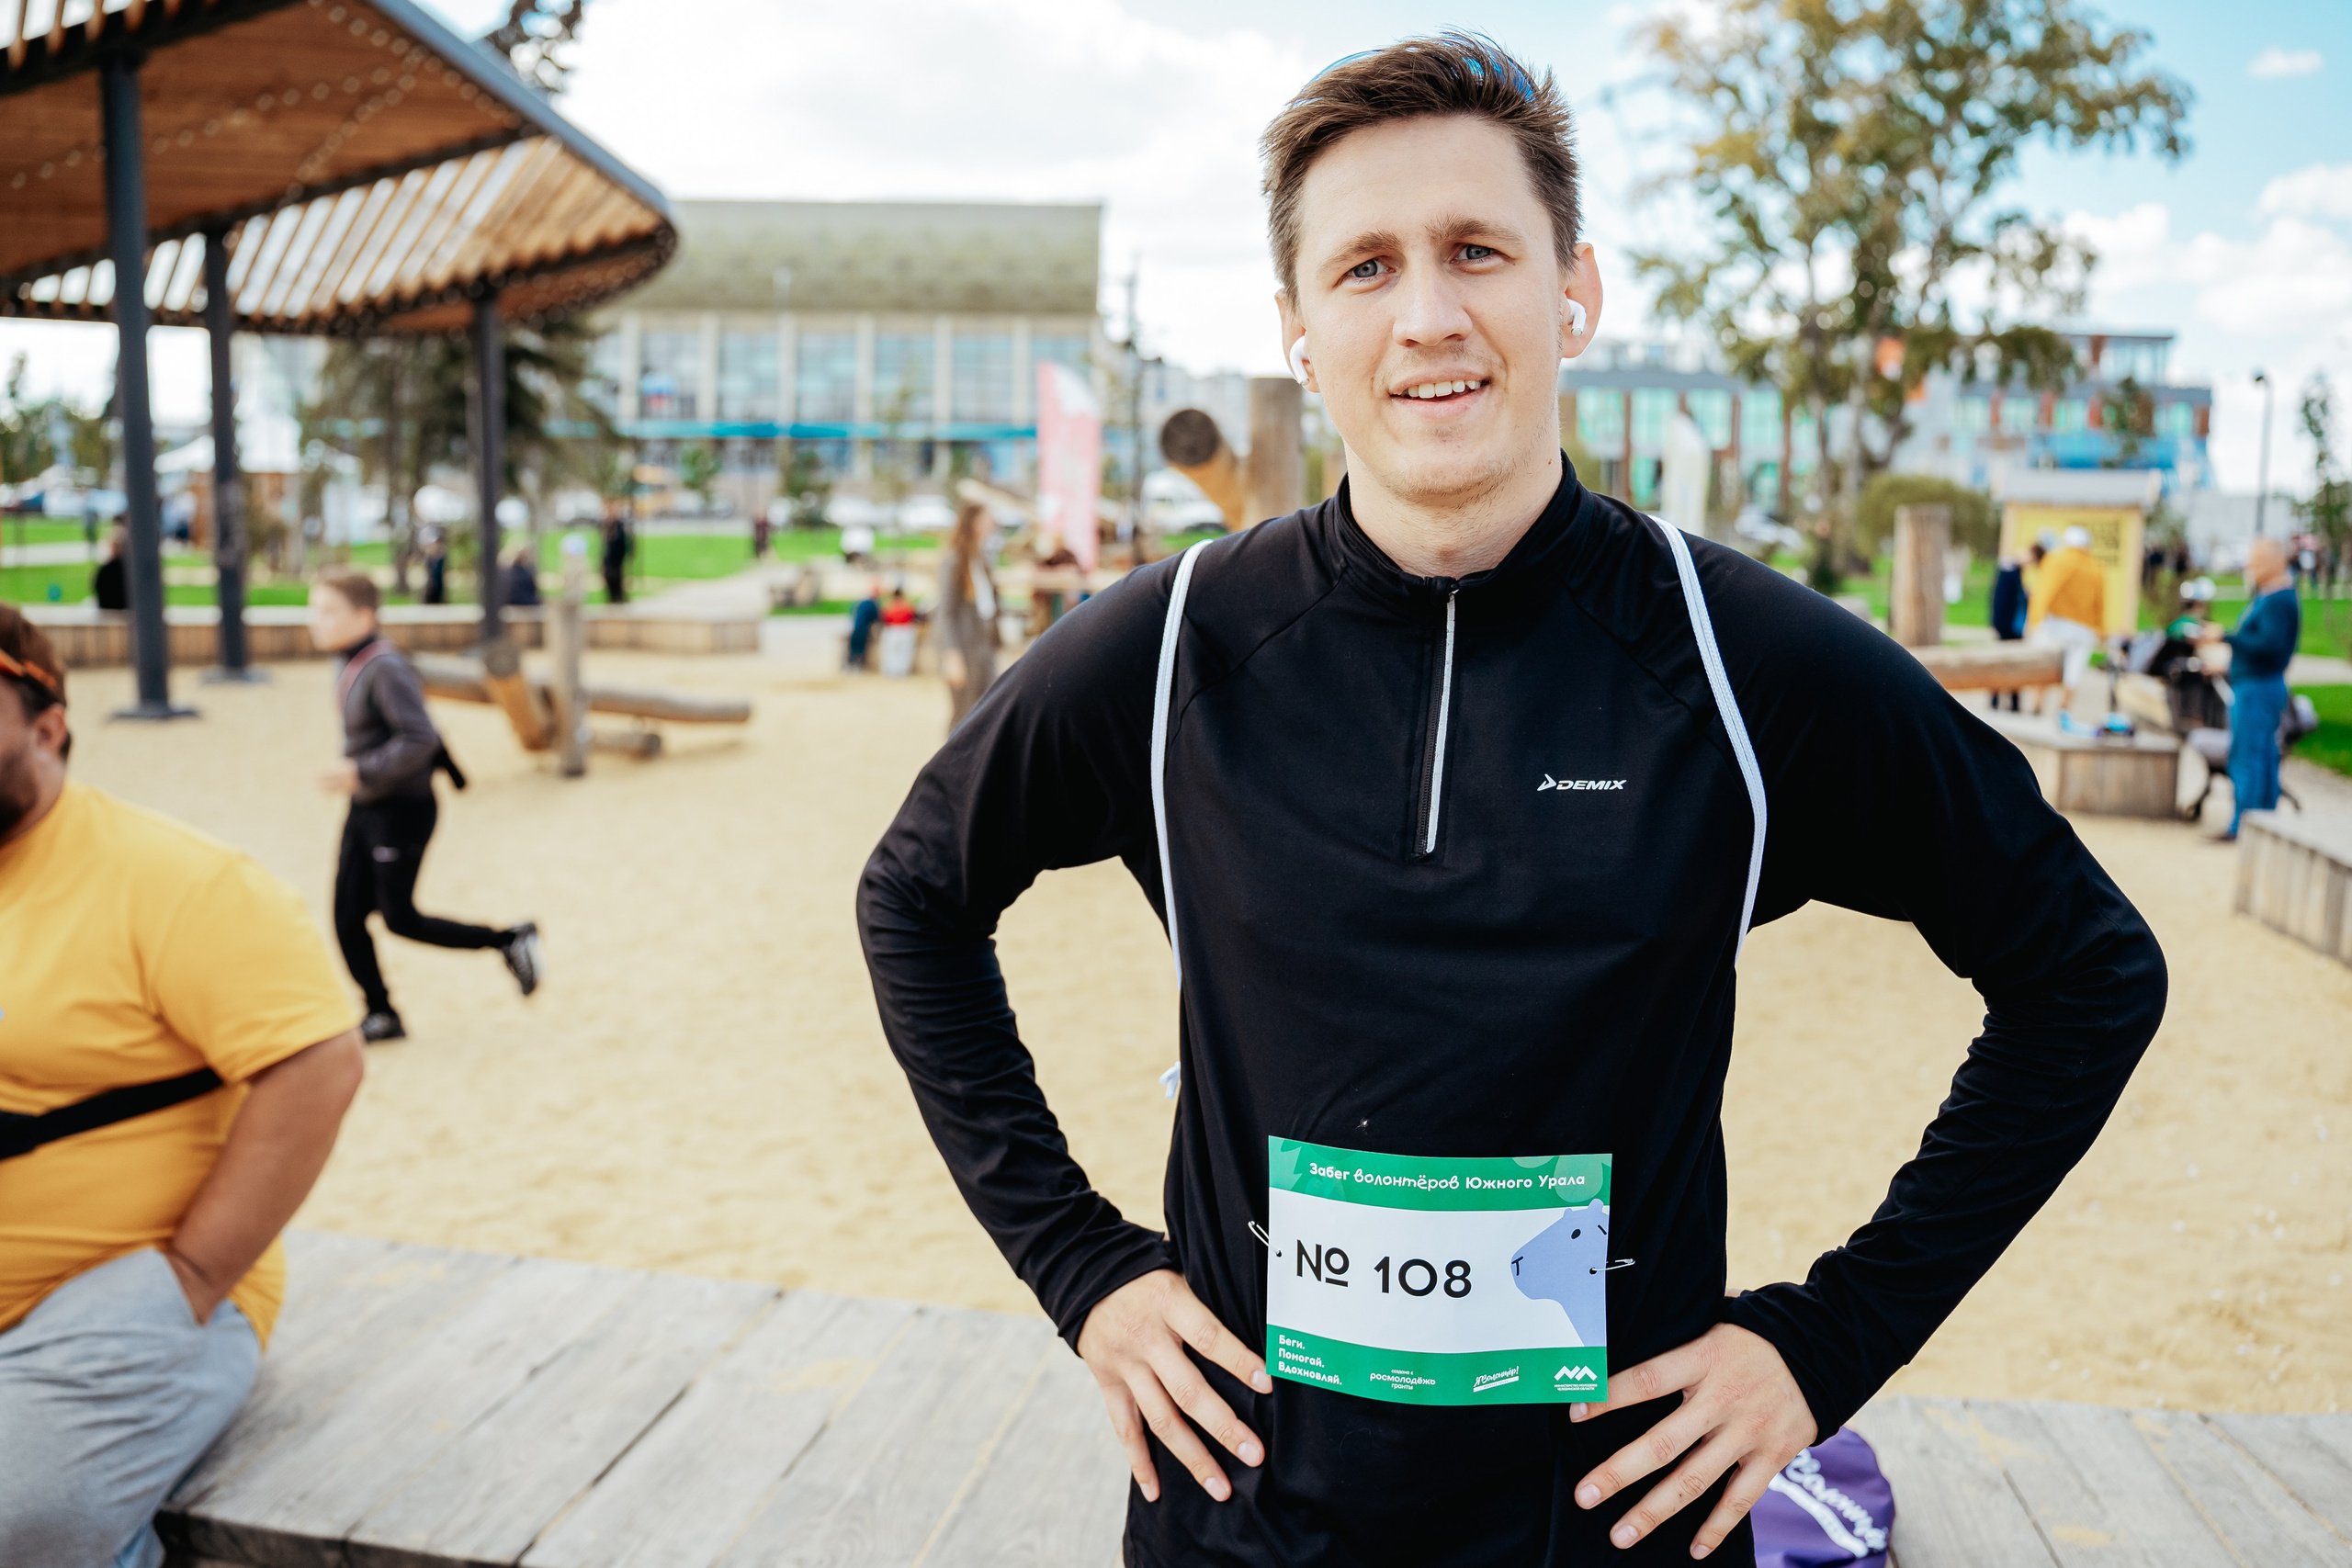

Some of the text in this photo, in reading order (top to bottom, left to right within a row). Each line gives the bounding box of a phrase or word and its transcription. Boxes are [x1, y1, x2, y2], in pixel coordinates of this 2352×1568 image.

[1555, 779, 1627, 790] DEMIX
[1308, 1162, 1586, 1192] Забег волонтёров Южного Урала
[1374, 1256, 1472, 1298] 108
[1278, 1334, 1306, 1350] Беги.
[1278, 1347, 1325, 1368] Помогай.
[1278, 1360, 1343, 1385] Вдохновляй.
[1369, 1372, 1436, 1385] росмолодёжь
